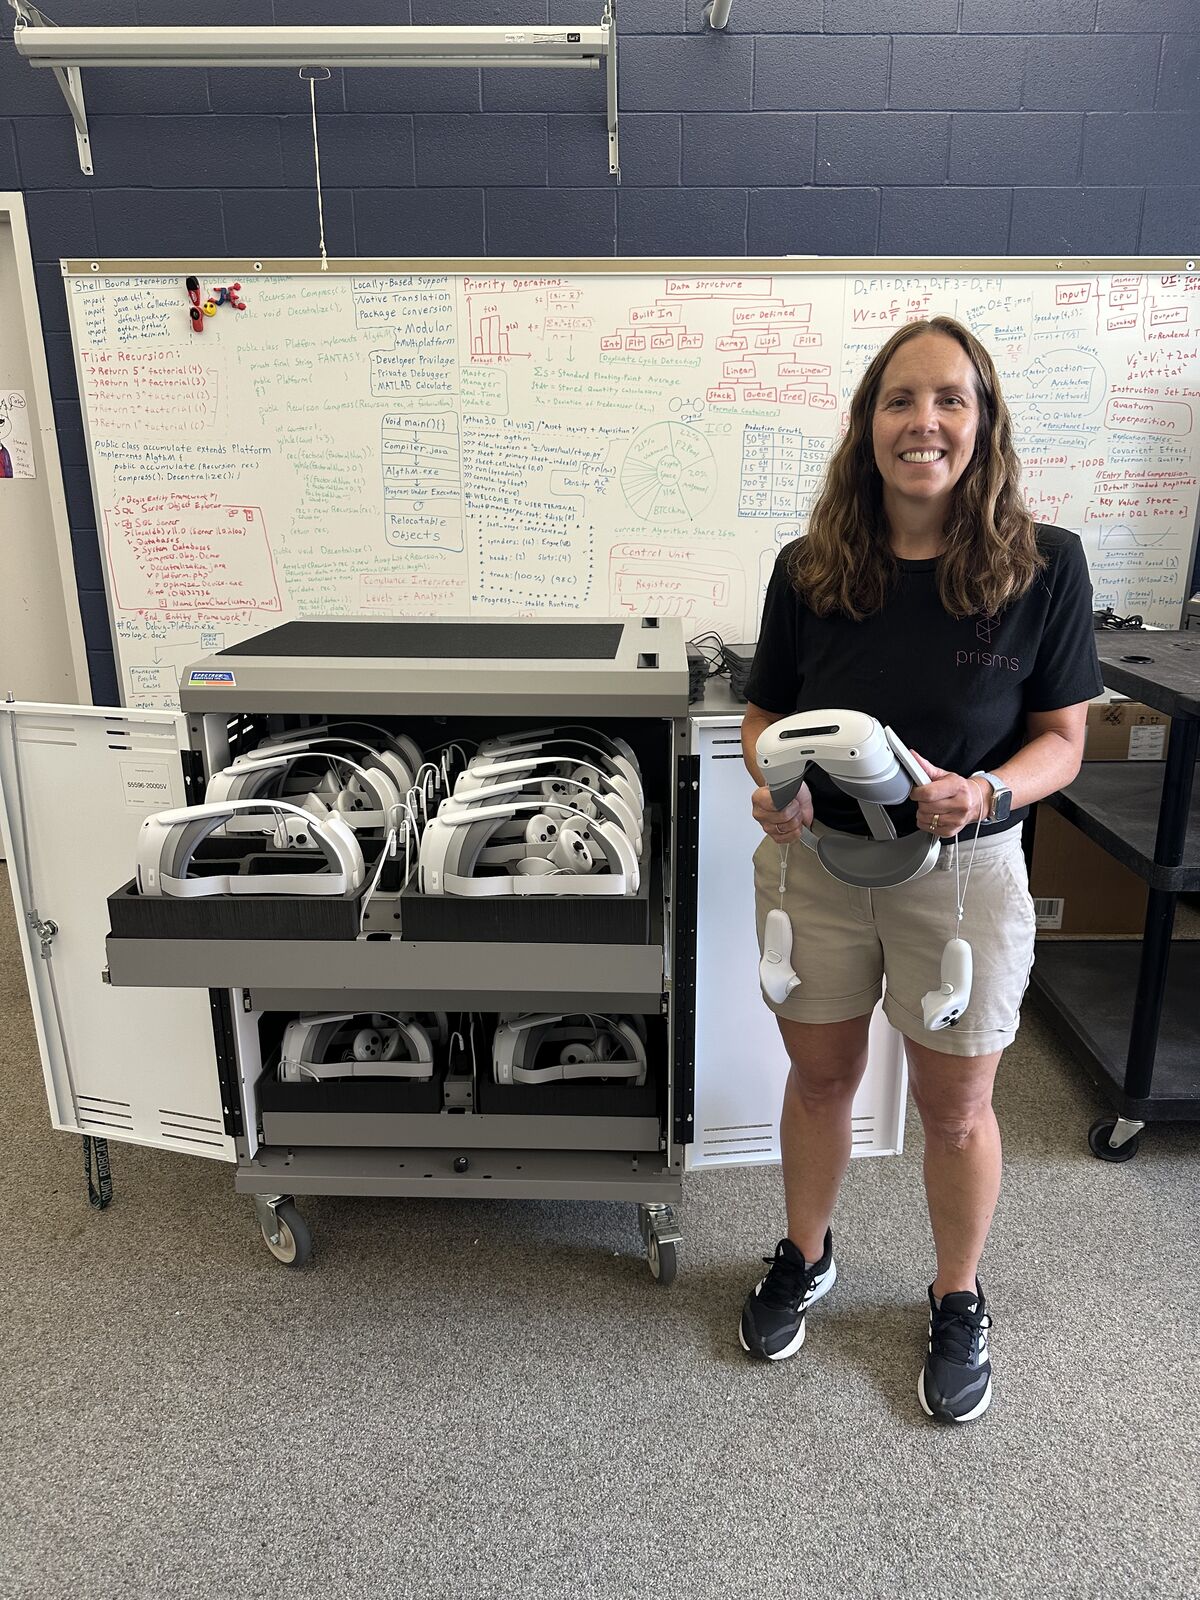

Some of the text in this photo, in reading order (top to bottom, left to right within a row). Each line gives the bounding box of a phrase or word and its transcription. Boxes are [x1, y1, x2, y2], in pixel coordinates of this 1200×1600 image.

[75, 279, 130, 291] Shell Bound
[418, 277, 448, 289] Support
[464, 277, 505, 292] Priority
[671, 281, 742, 290] Data Structure
[360, 305, 453, 320] Package Conversion
[632, 309, 673, 320] Built In
[736, 311, 756, 320] User
[405, 320, 452, 334] Modular
[603, 340, 619, 348] Int
[653, 338, 671, 346] Chr
[718, 340, 745, 349] Array
[759, 337, 777, 345] List
[799, 336, 816, 344] File
[118, 350, 180, 361] Recursion:
[98, 367, 128, 376] Return
[411, 369, 449, 379] Debugger
[726, 366, 753, 375] Linear
[1054, 365, 1083, 374] action
[99, 378, 128, 387] Return
[378, 381, 452, 390] MATLAB Calculate
[1111, 385, 1159, 395] Instruction
[709, 391, 732, 399] Stack
[783, 392, 803, 401] Tree
[1113, 401, 1154, 411] Quantum
[1111, 414, 1176, 429] Superposition
[778, 427, 803, 435] Growth
[477, 432, 499, 440] import
[746, 435, 757, 444] 50
[95, 440, 272, 454] public class accumulate extends Platform
[808, 439, 825, 448] 506
[114, 461, 136, 473] public
[1125, 471, 1147, 479] Period
[473, 484, 496, 492] return
[473, 493, 509, 505] WELCOME
[524, 500, 541, 508] USER
[544, 503, 577, 512] TERMINAL
[1100, 497, 1139, 506] Key Value
[391, 515, 446, 525] Relocatable
[392, 530, 440, 541] Objects
[622, 546, 661, 557] Control
[636, 580, 681, 590] Registers
[414, 592, 454, 603] Analysis
[956, 649, 1019, 671] prisms
[101, 1179, 113, 1201] OHIO
